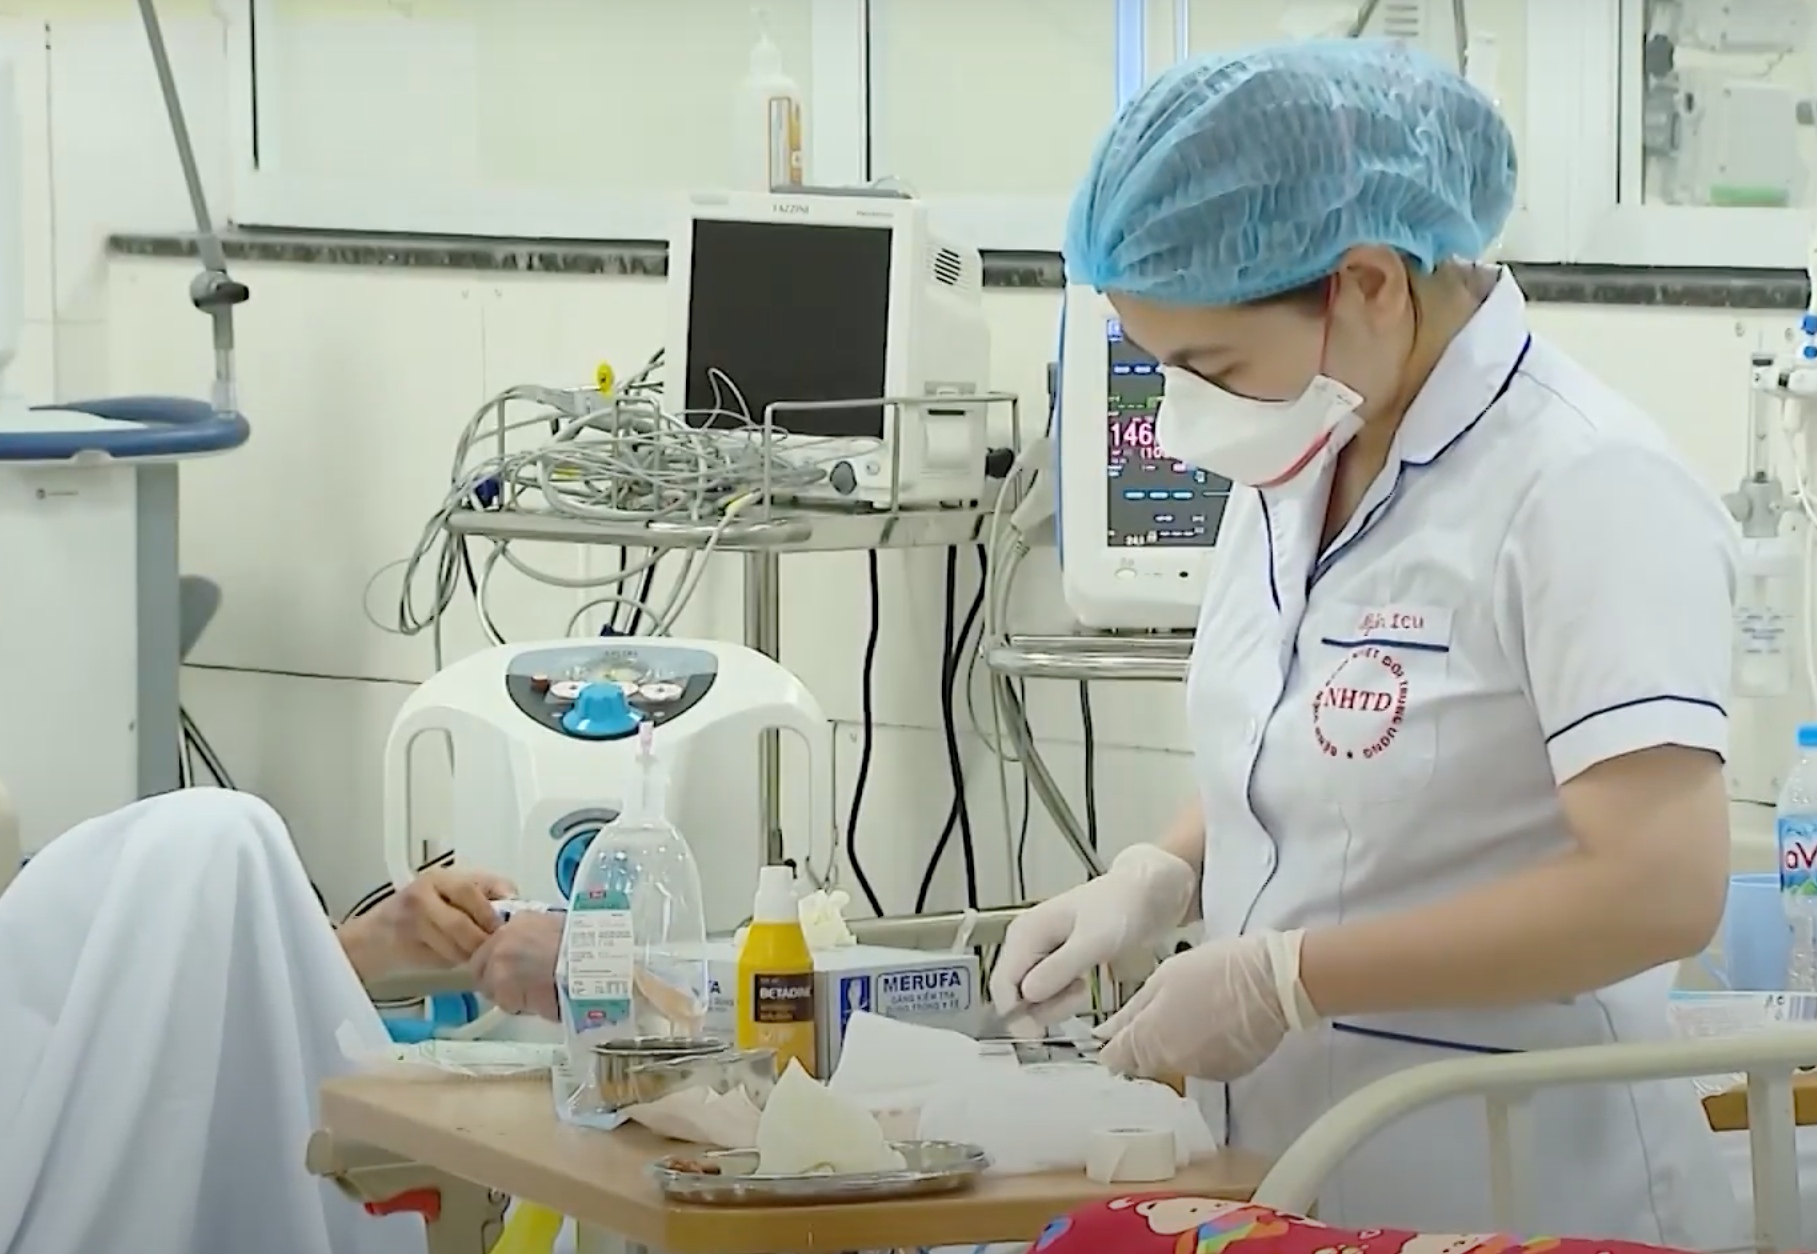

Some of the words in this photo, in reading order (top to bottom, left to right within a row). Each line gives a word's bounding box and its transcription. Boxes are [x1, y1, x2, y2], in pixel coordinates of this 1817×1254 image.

[1111, 422, 1153, 447] 146
[1325, 687, 1392, 712] NHTD
[883, 970, 962, 993] MERUFA
